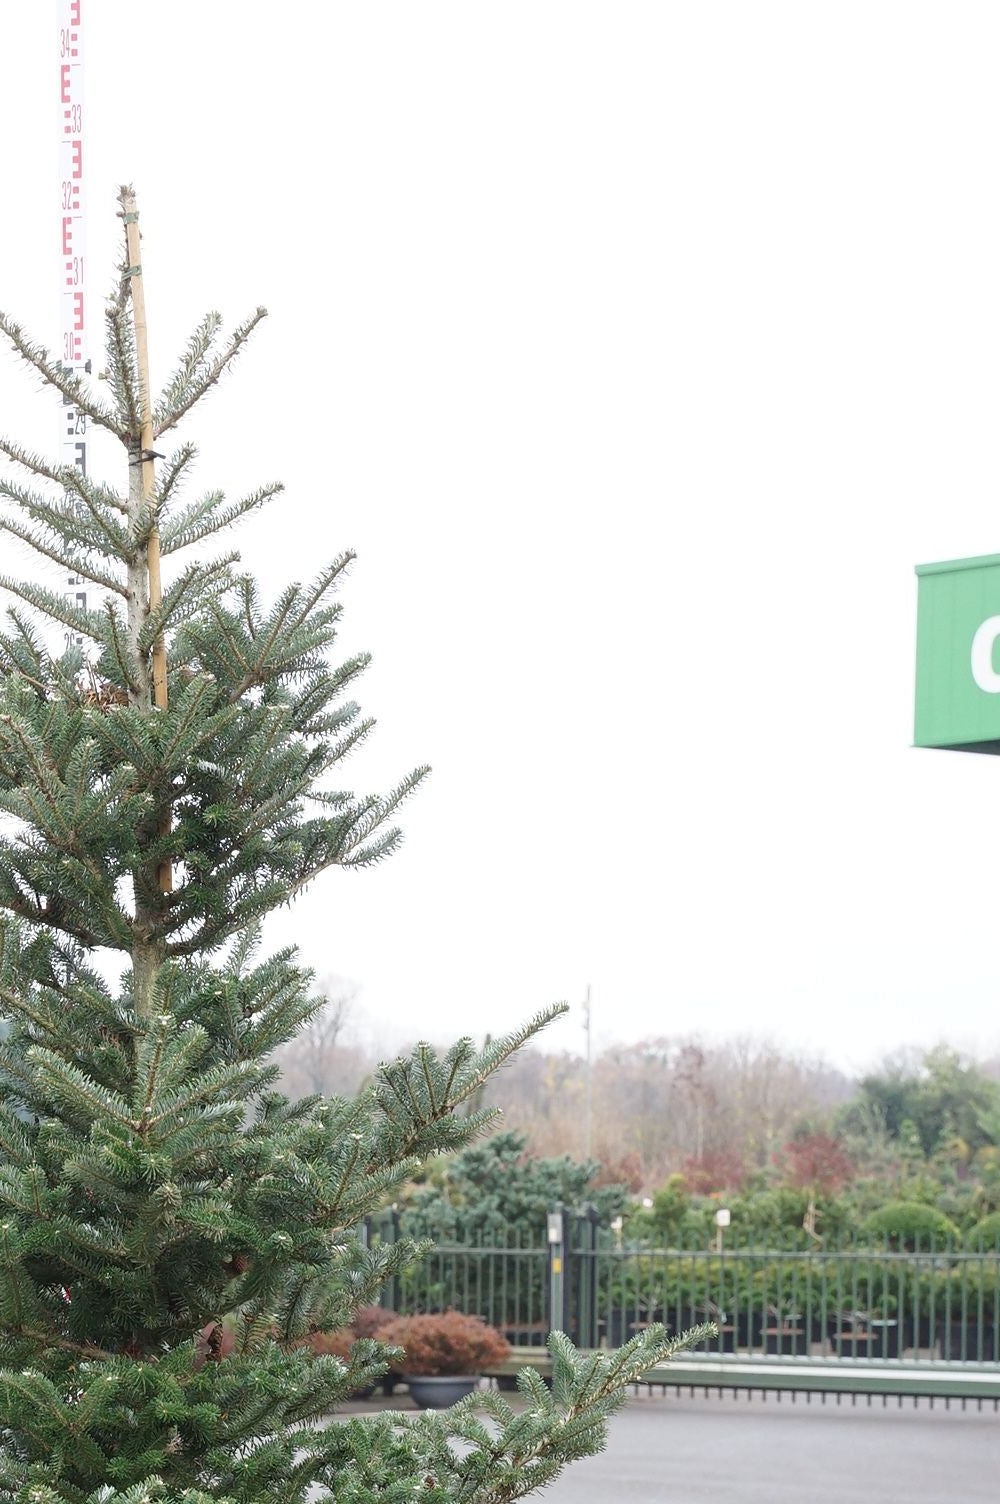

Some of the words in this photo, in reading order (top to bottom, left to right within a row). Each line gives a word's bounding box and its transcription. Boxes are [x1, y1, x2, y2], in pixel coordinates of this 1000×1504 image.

[60, 28, 70, 58] 34
[71, 104, 82, 133] 33
[62, 181, 72, 210] 32
[73, 256, 84, 286] 31
[63, 332, 73, 361] 30
